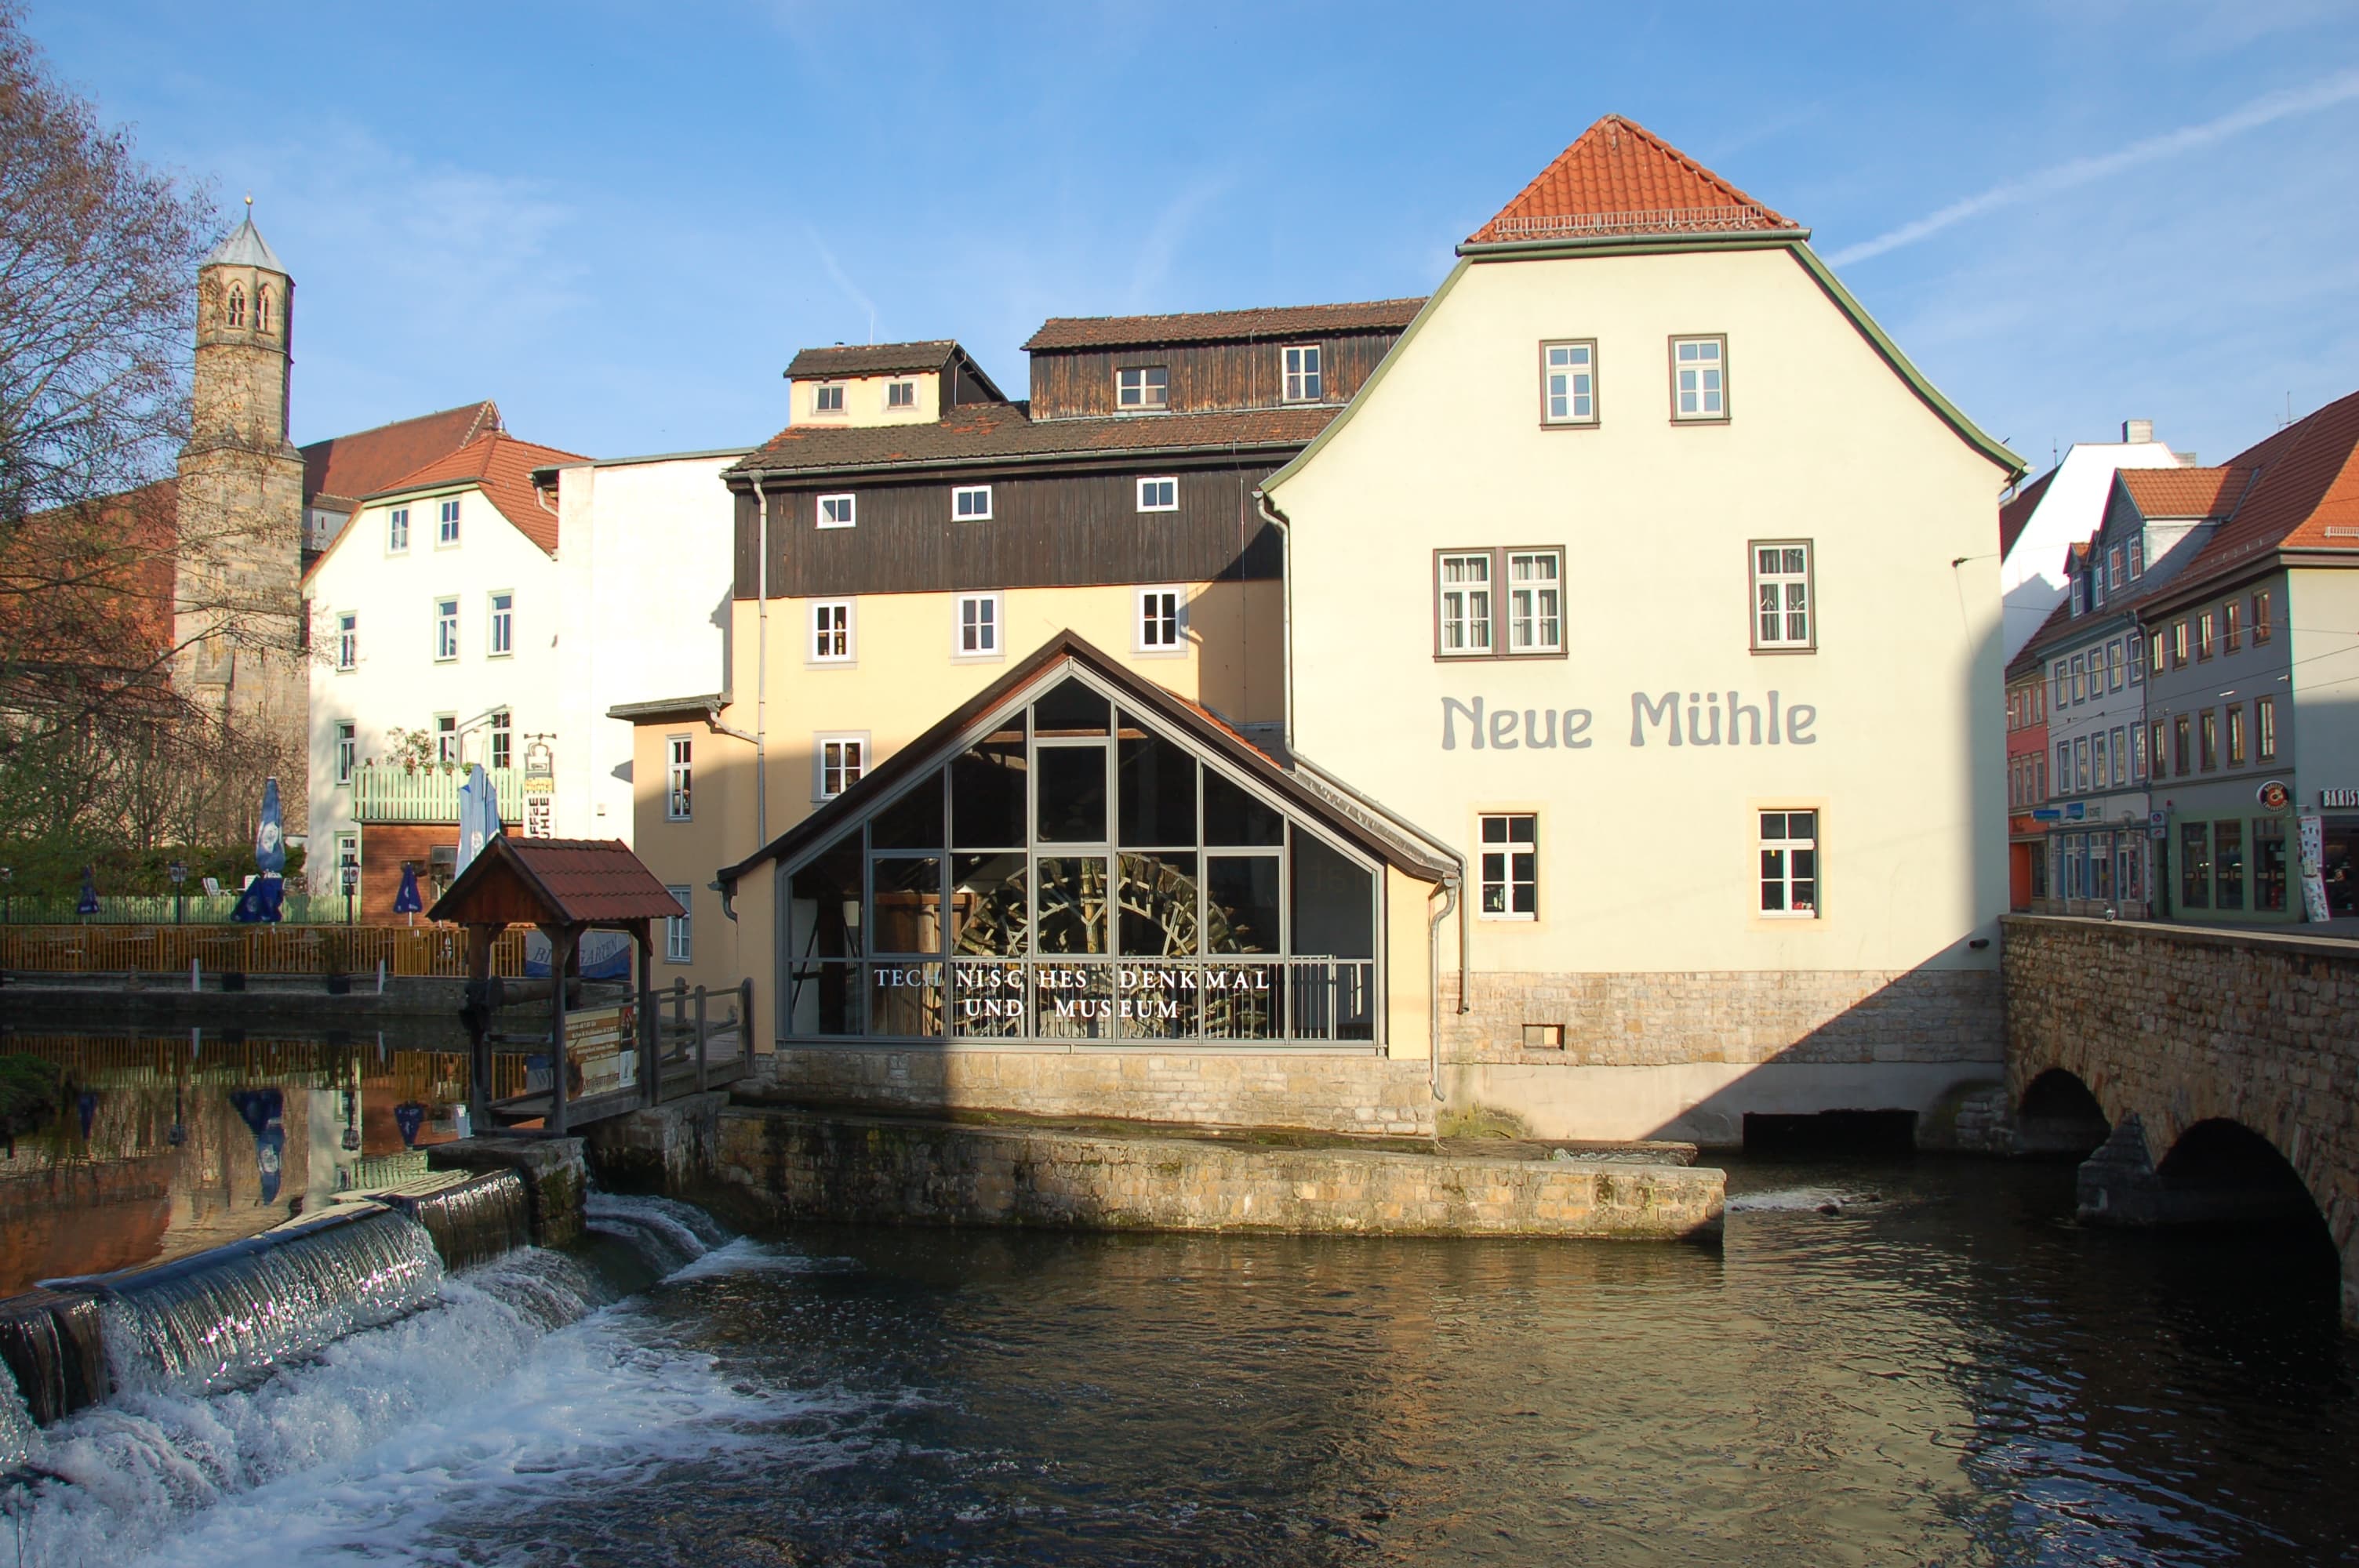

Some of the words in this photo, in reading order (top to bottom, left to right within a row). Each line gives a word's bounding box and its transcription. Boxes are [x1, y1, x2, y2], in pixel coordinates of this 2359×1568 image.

[1441, 695, 1593, 750] Neue
[1630, 690, 1817, 747] Mühle
[1119, 971, 1270, 989] DENKMAL
[965, 999, 1023, 1018] UND
[1056, 1000, 1179, 1018] MUSEUM
